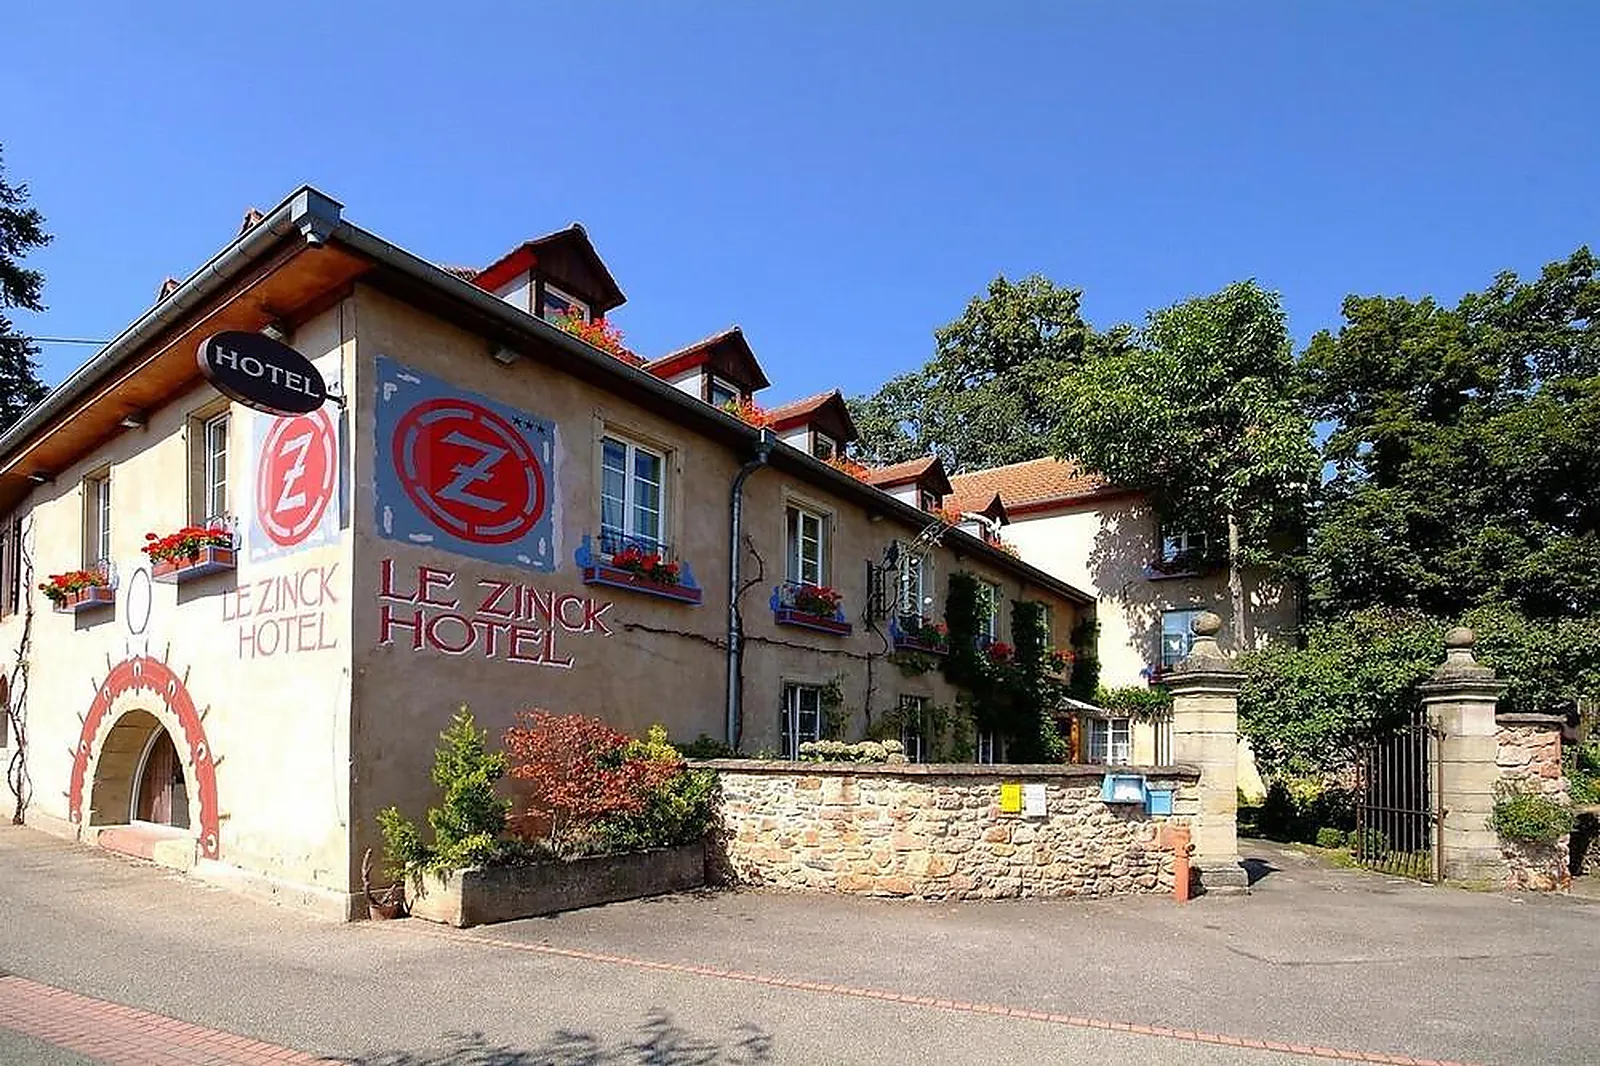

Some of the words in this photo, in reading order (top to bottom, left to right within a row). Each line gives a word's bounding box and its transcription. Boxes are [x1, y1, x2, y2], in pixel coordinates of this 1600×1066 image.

[215, 345, 320, 398] HOTEL
[222, 584, 252, 622] LE
[257, 563, 340, 614] ZINCK
[379, 559, 459, 609] LE
[476, 579, 614, 637] ZINCK
[238, 611, 337, 660] HOTEL
[379, 604, 575, 668] HOTEL
